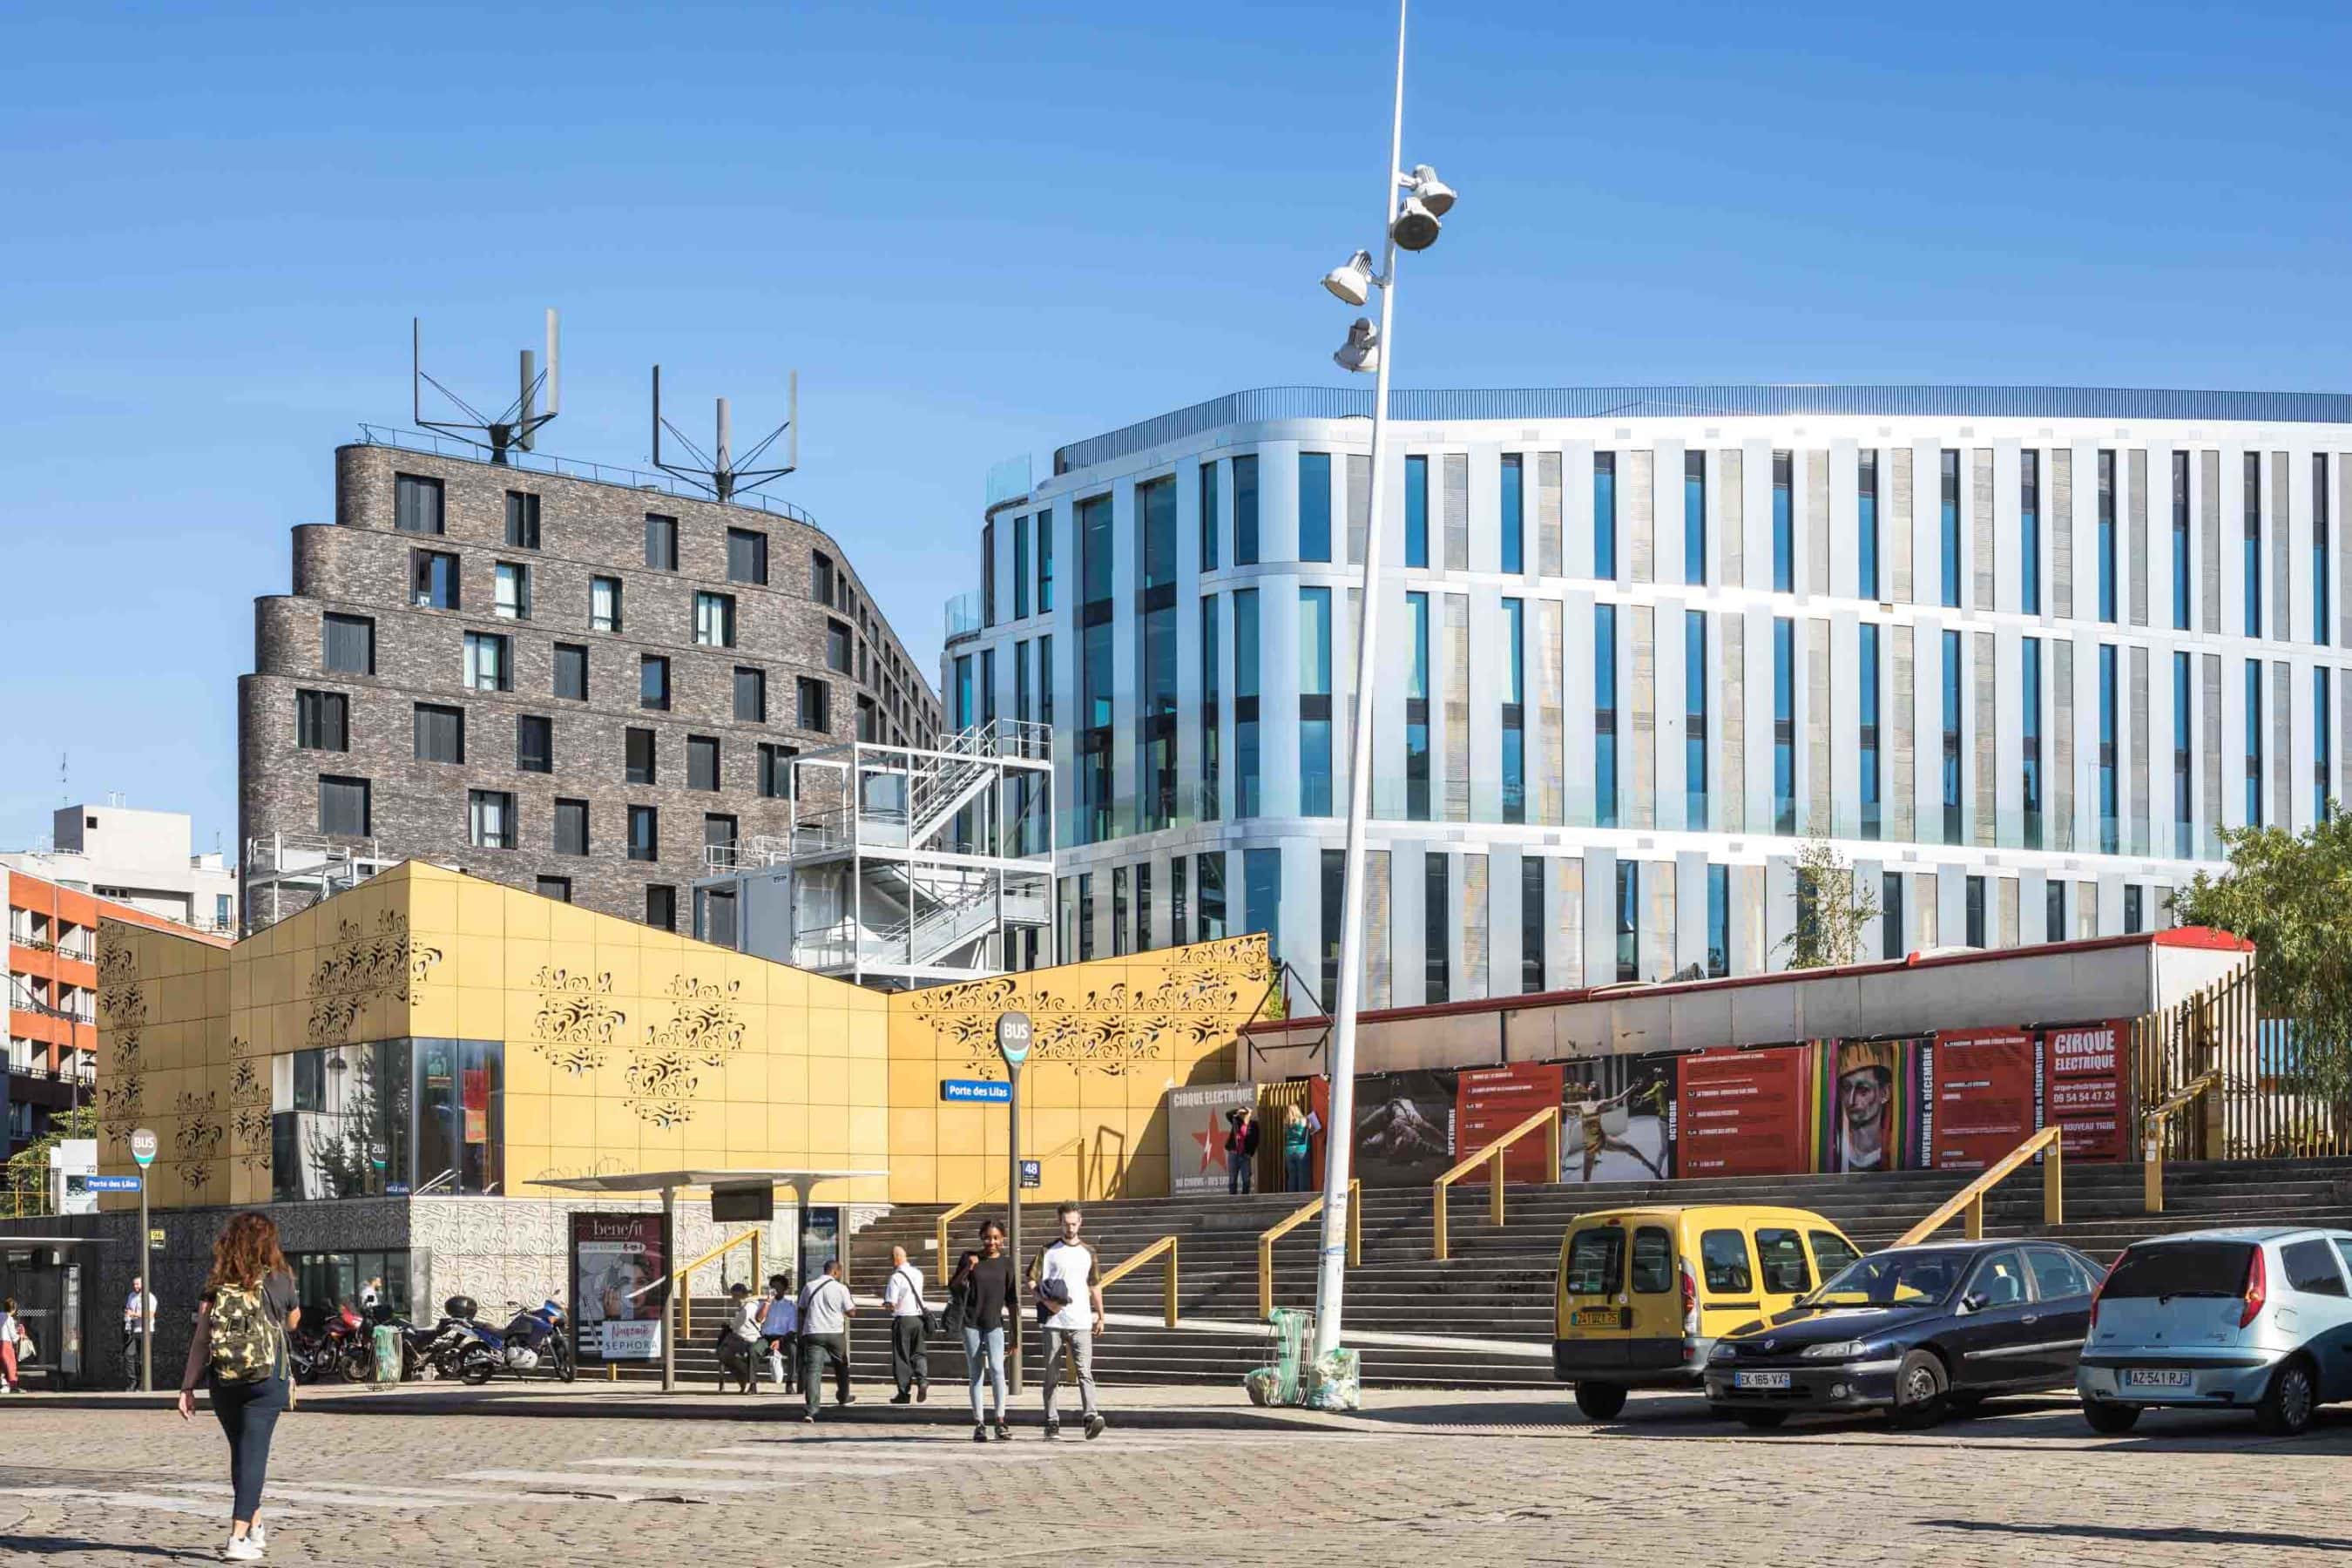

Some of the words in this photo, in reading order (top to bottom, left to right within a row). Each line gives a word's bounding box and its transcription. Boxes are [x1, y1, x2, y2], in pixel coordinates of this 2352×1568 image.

[1004, 1023, 1029, 1039] BUS
[2054, 1030, 2115, 1055] CIRQUE
[2055, 1054, 2115, 1071] ELECTRIQUE
[1922, 1047, 1933, 1101] DÉCEMBRE
[950, 1085, 972, 1096] Porte
[973, 1086, 988, 1096] des
[990, 1087, 1008, 1098] Lilas
[1173, 1092, 1204, 1108] CIRQUE
[1205, 1087, 1254, 1105] ELECTRIQUE
[2054, 1092, 2064, 1103] 09
[2066, 1092, 2077, 1102] 54
[2079, 1092, 2089, 1101] 54
[2092, 1092, 2102, 1101] 47
[2105, 1091, 2115, 1100] 24
[1668, 1100, 1677, 1141] OCTOBRE
[133, 1136, 154, 1148] BUS
[1922, 1112, 1932, 1166] NOVEMBRE
[1024, 1163, 1038, 1175] 48
[593, 1220, 643, 1239] benefit
[605, 1340, 657, 1351] SEPHORA
